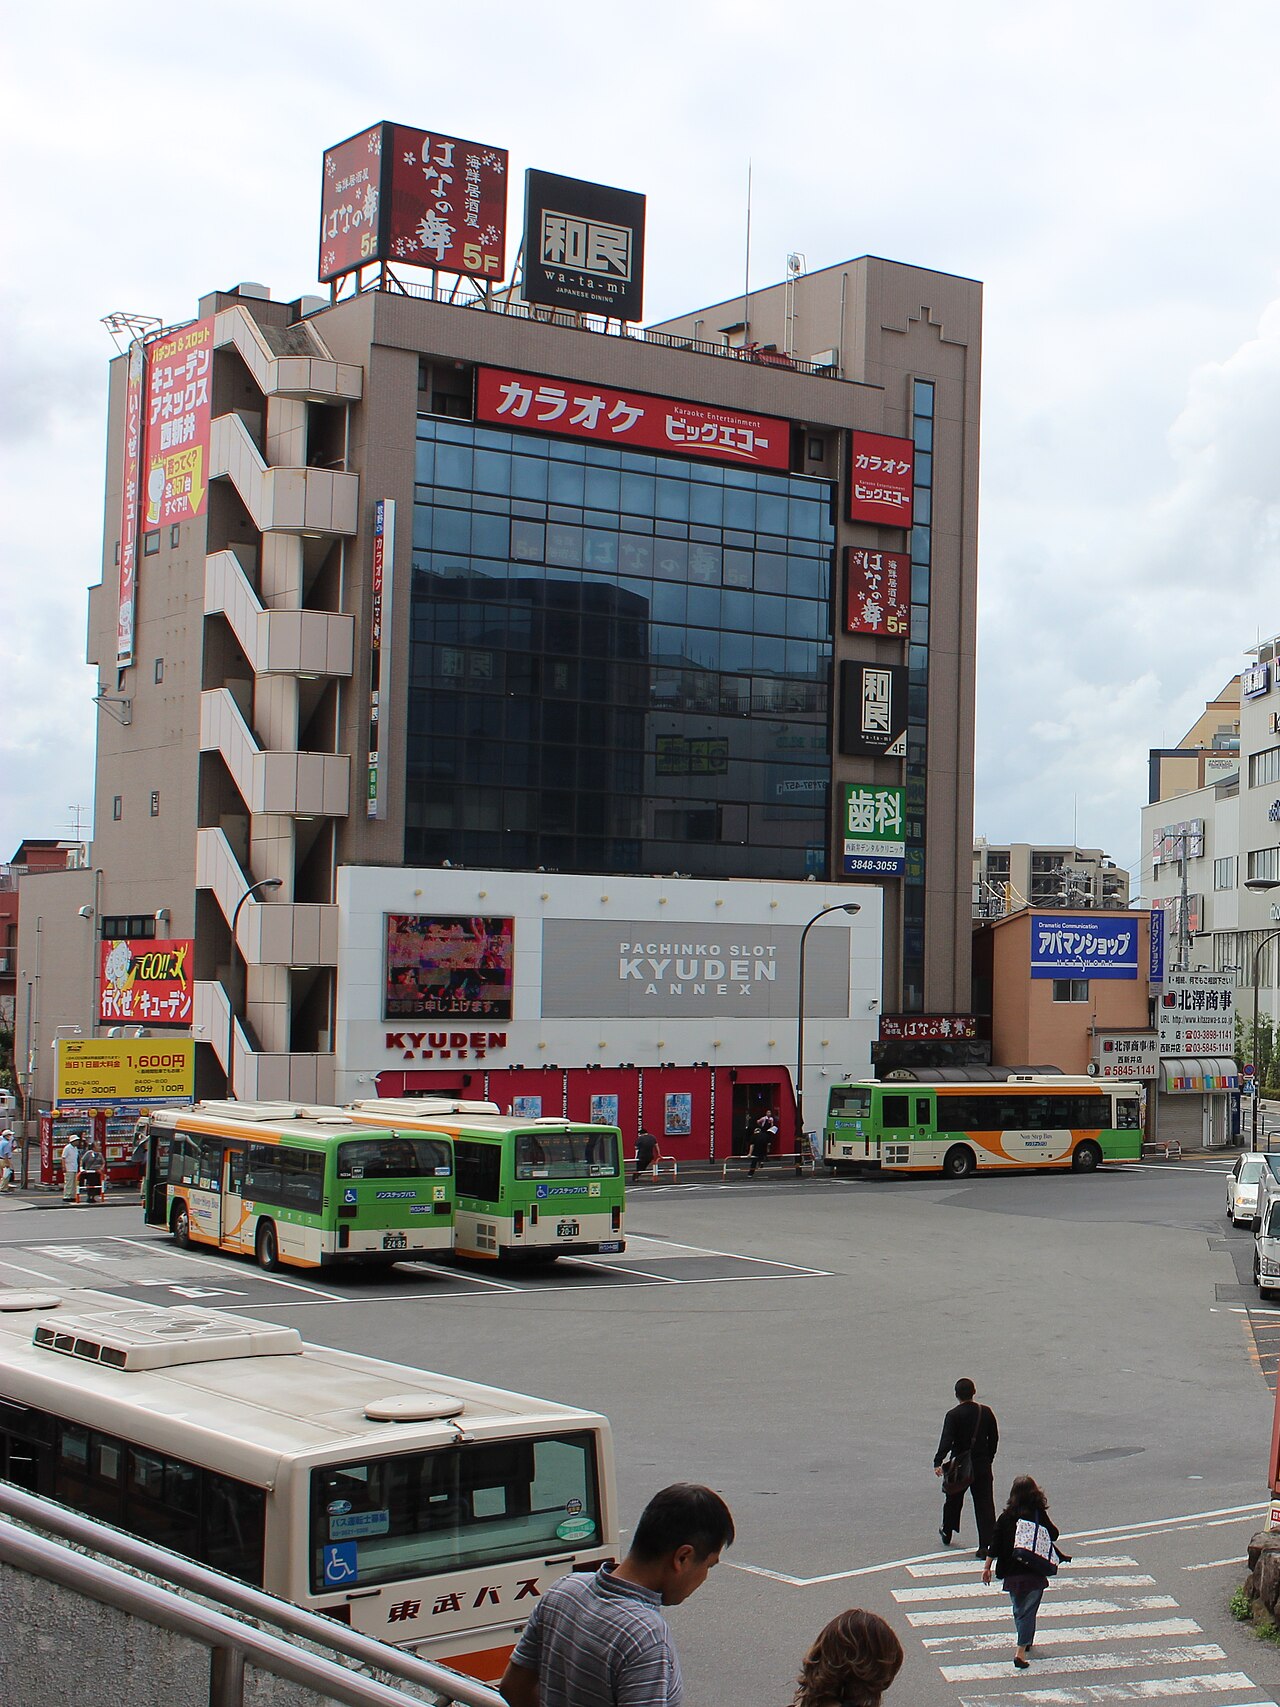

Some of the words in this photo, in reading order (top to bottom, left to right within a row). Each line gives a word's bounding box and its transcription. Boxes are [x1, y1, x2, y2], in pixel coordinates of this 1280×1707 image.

[415, 136, 456, 262] はなの舞
[464, 154, 481, 229] 海鮮居酒屋
[361, 232, 377, 257] 5F
[545, 217, 627, 275] 和民
[462, 243, 499, 273] 5F
[555, 287, 589, 300] JAPANESE
[591, 293, 614, 304] DINING
[152, 349, 209, 394] キューデン
[151, 378, 208, 426] アネックス
[496, 381, 645, 433] カラオケ
[673, 406, 705, 419] Karaoke
[706, 411, 761, 428] Entertainment
[160, 413, 195, 450] 西新井
[665, 414, 769, 453] ビッグエコー
[855, 454, 911, 475] カラオケ
[855, 485, 910, 504] ビッグエコー
[861, 552, 884, 631] はなの舞
[887, 616, 908, 634] 5F
[865, 672, 889, 731] 和民
[892, 743, 906, 754] 4F
[848, 790, 902, 835] 歯科
[851, 860, 898, 871] 3848-3055
[1061, 922, 1098, 930] Communication
[620, 943, 721, 956] PACHINKO
[729, 946, 777, 957] SLOT
[1038, 930, 1131, 956] アパマンショップ
[1151, 913, 1159, 974] アパマンショップ
[619, 958, 776, 981] KYUDEN
[645, 984, 751, 995] ANNEX
[140, 990, 191, 1018] キューデン
[1178, 990, 1233, 1011] 北澤商事
[1160, 1015, 1170, 1024] URL
[386, 1033, 507, 1049] KYUDEN
[966, 1028, 976, 1037] 5F
[1193, 1030, 1232, 1039] 03-3898-1141
[403, 1050, 486, 1059] ANNEX
[1193, 1043, 1232, 1052] 03-5845-1141
[126, 1054, 185, 1069] 1,600円
[1112, 1065, 1155, 1075] 5845-1141
[1117, 1056, 1143, 1064] 西新井店
[65, 1086, 84, 1095] 60分
[92, 1086, 116, 1095] 300円
[134, 1085, 153, 1093] 60分
[161, 1084, 184, 1092] 100円
[387, 1577, 541, 1624] 東武バス
